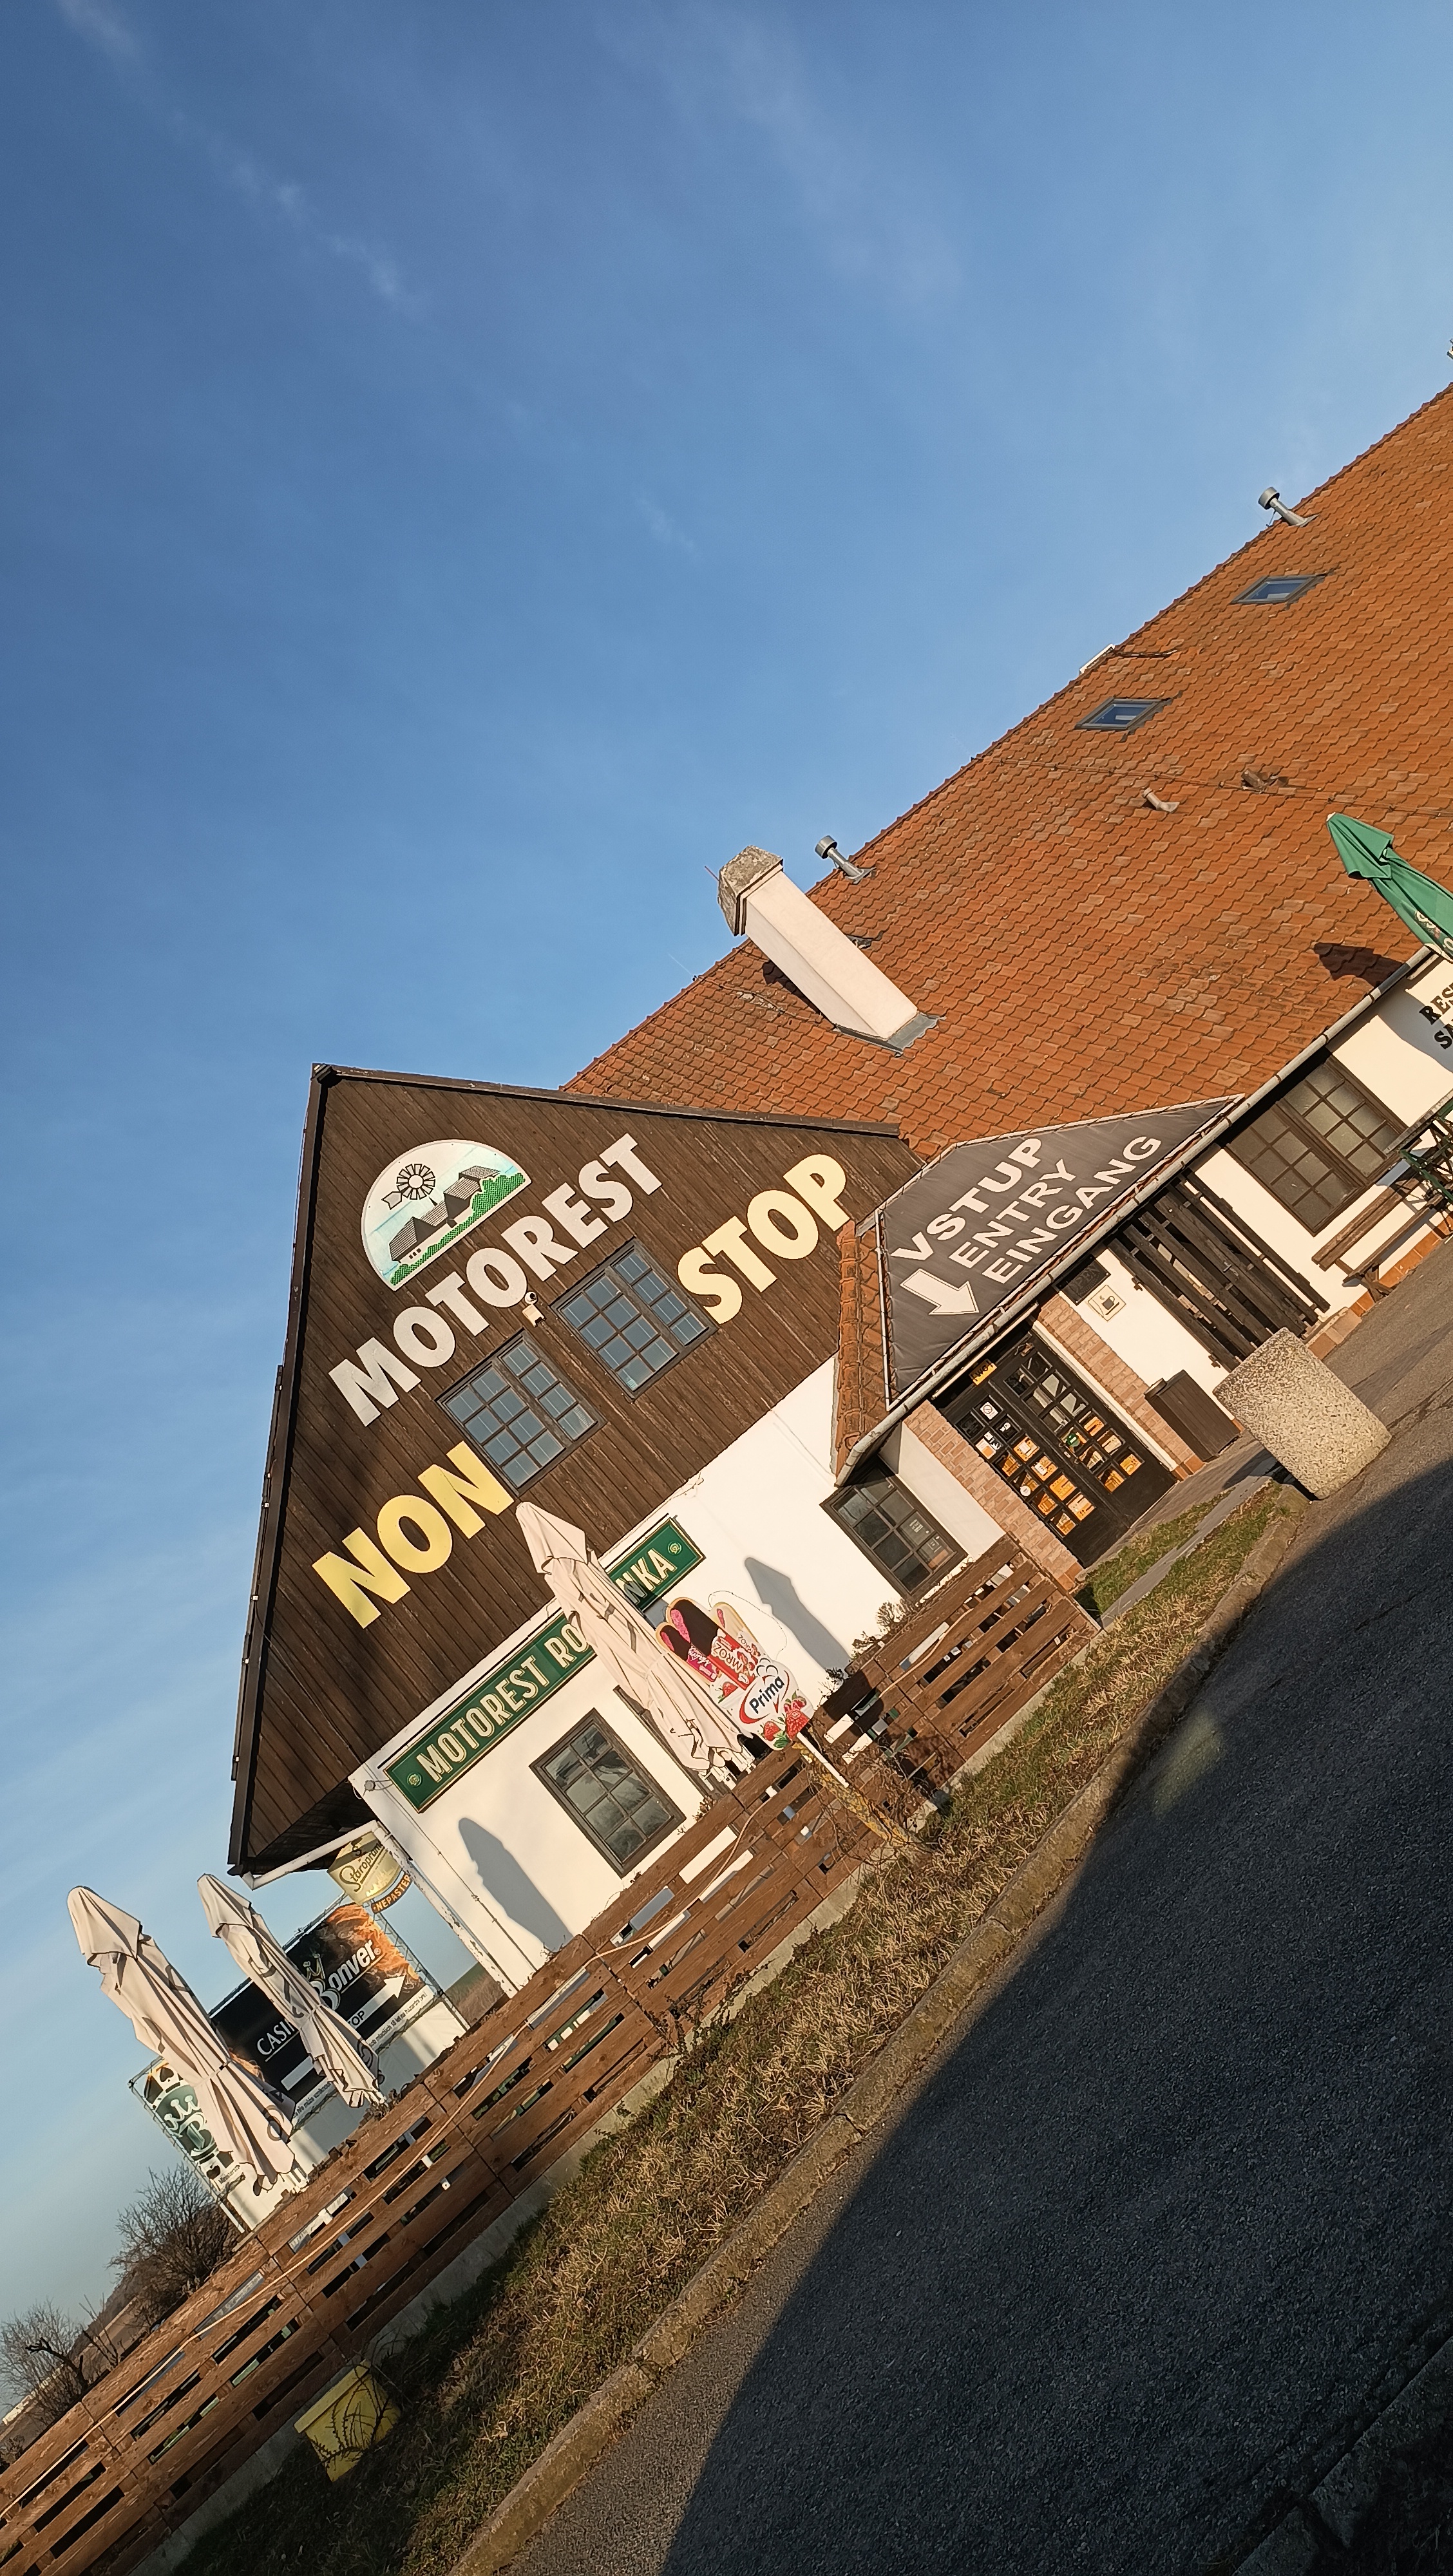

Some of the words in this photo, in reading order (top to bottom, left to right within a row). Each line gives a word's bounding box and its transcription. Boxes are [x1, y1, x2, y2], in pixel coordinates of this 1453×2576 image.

[1419, 983, 1453, 1025] RES
[678, 1153, 851, 1324] STOP
[891, 1139, 1041, 1261] VSTUP
[949, 1159, 1076, 1269] ENTRY
[982, 1136, 1161, 1283] EINGANG
[328, 1133, 662, 1426] MOTOREST
[312, 1441, 515, 1629] NON
[416, 1654, 550, 1783] MOTOREST
[544, 1548, 678, 1669] RONKA
[748, 1674, 786, 1715] Prima
